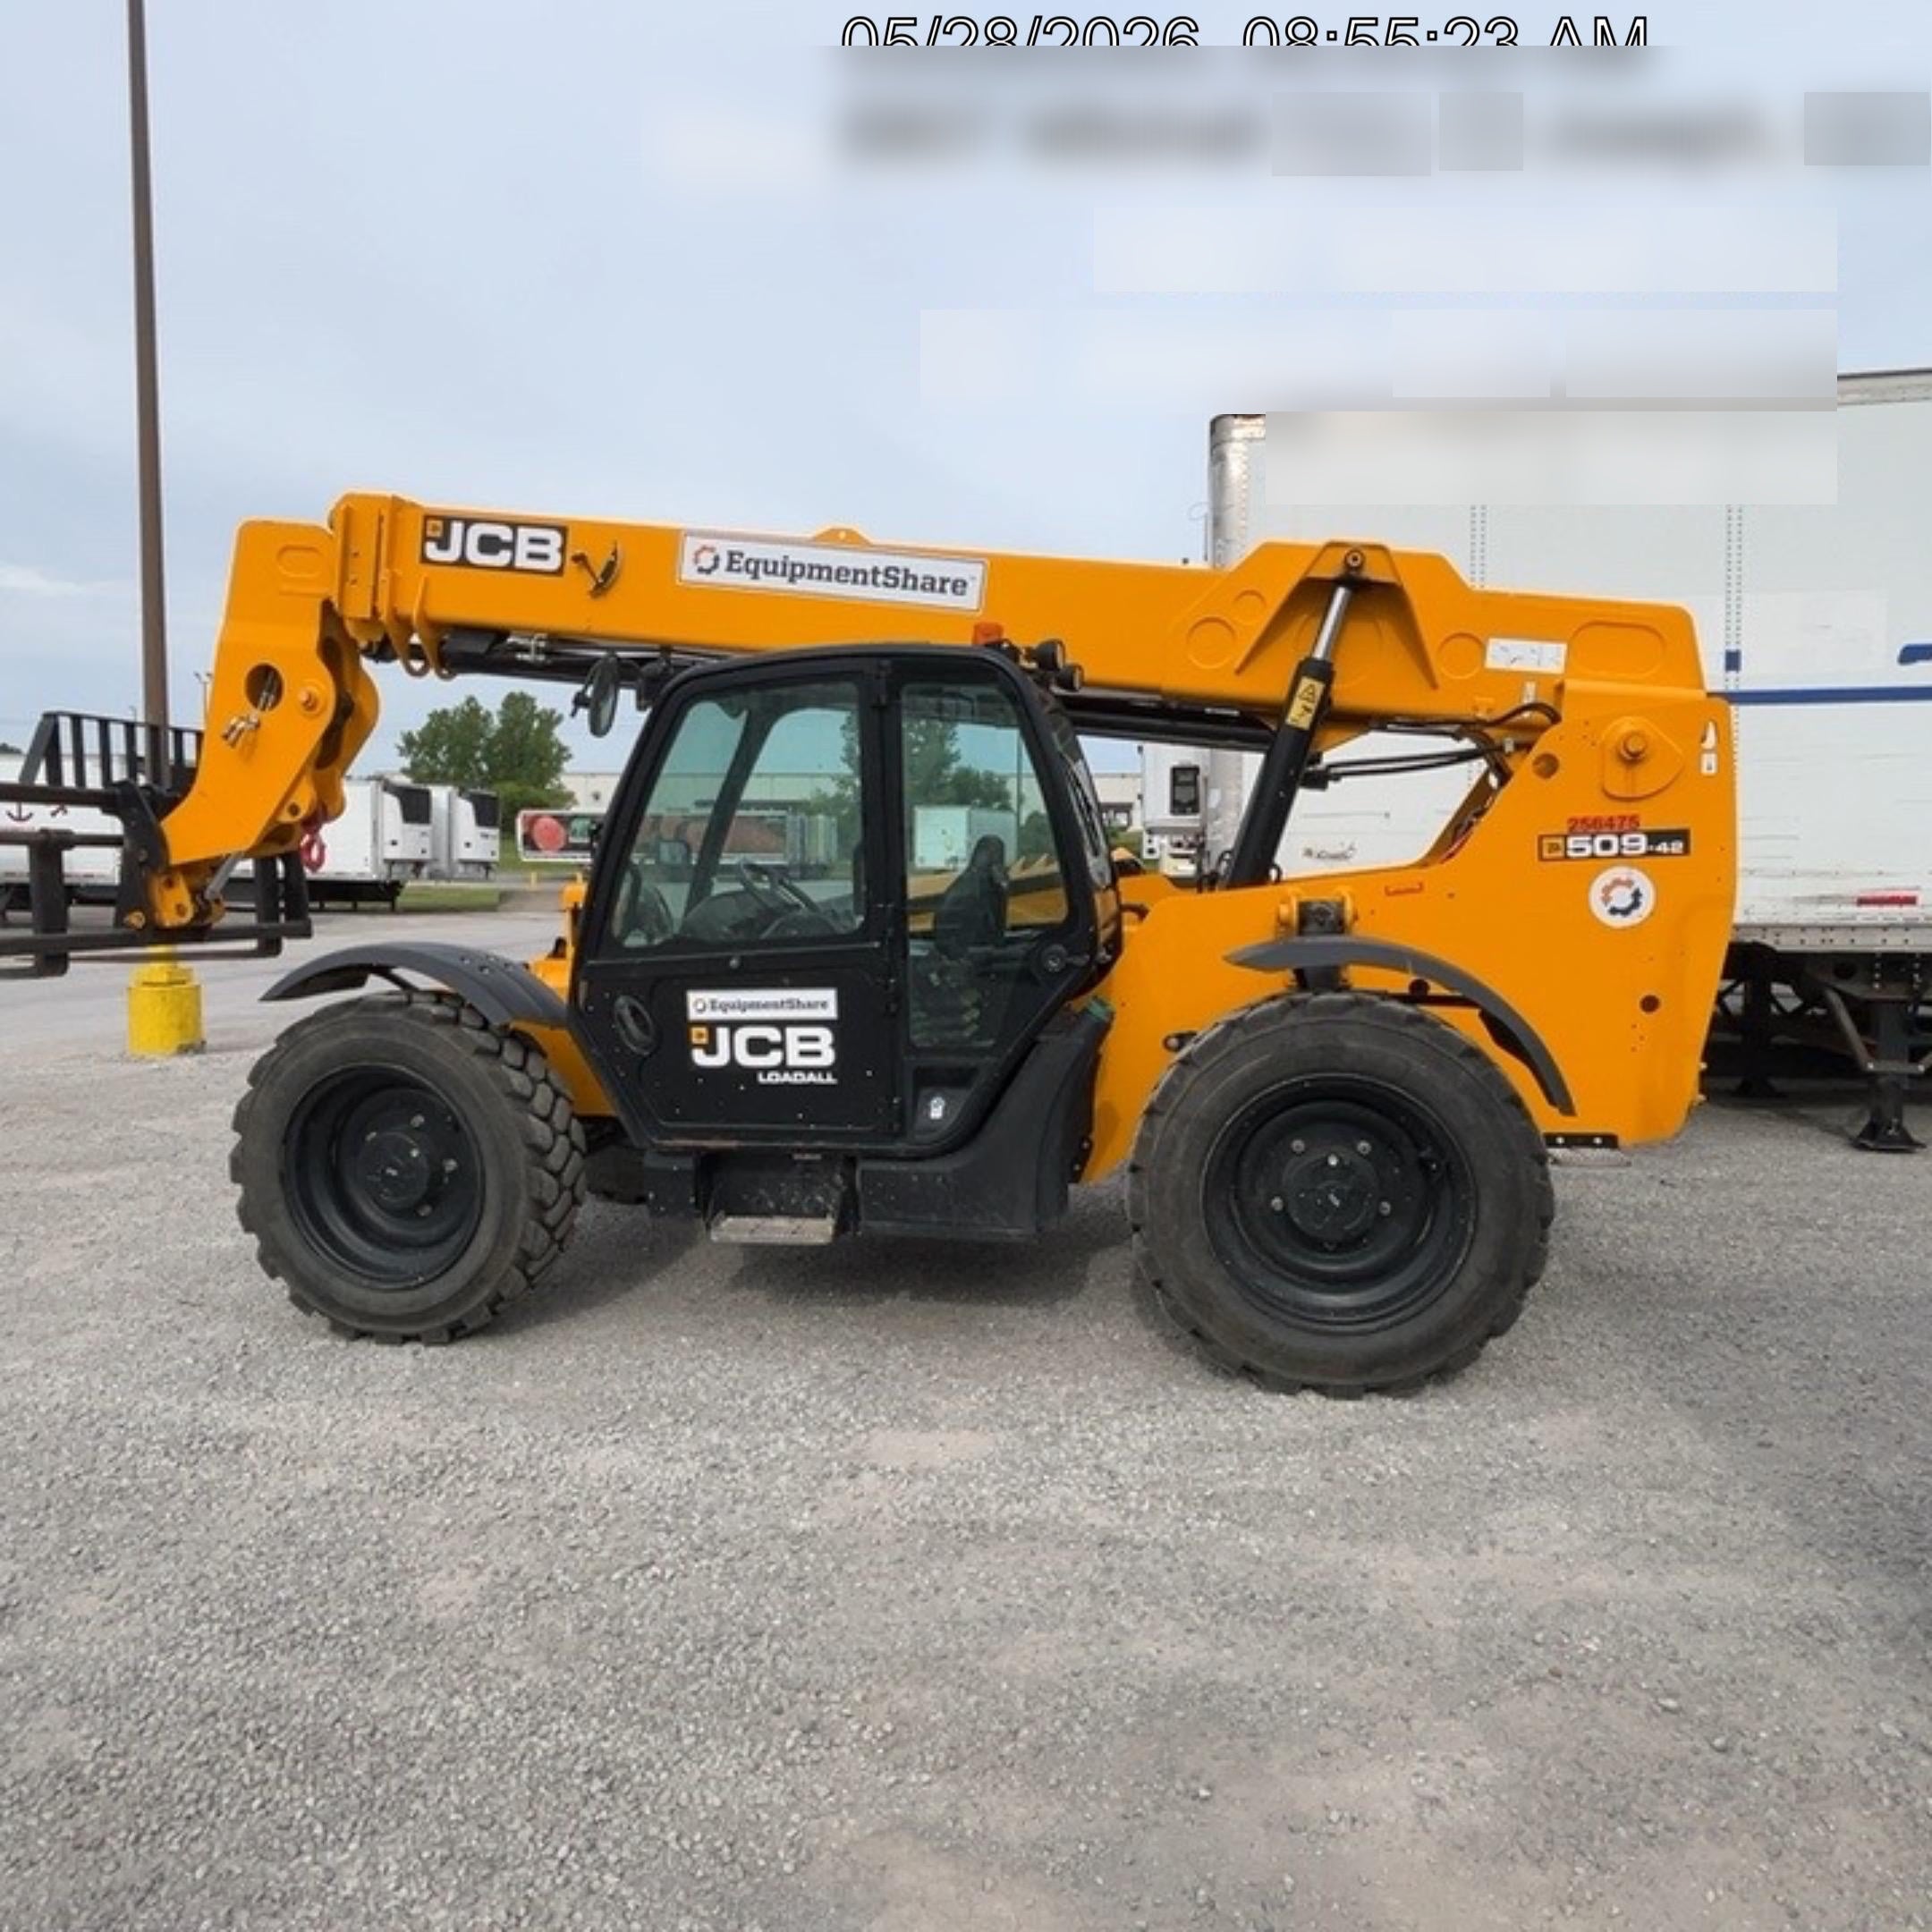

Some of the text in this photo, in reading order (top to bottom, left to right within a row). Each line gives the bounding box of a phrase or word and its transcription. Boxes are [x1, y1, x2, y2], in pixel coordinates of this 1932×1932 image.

[425, 520, 563, 572] JCB
[724, 550, 969, 597] EquipmentShare
[709, 999, 828, 1013] EquipmentShare
[691, 1026, 836, 1067] JCB
[757, 1071, 838, 1085] LOADALL
